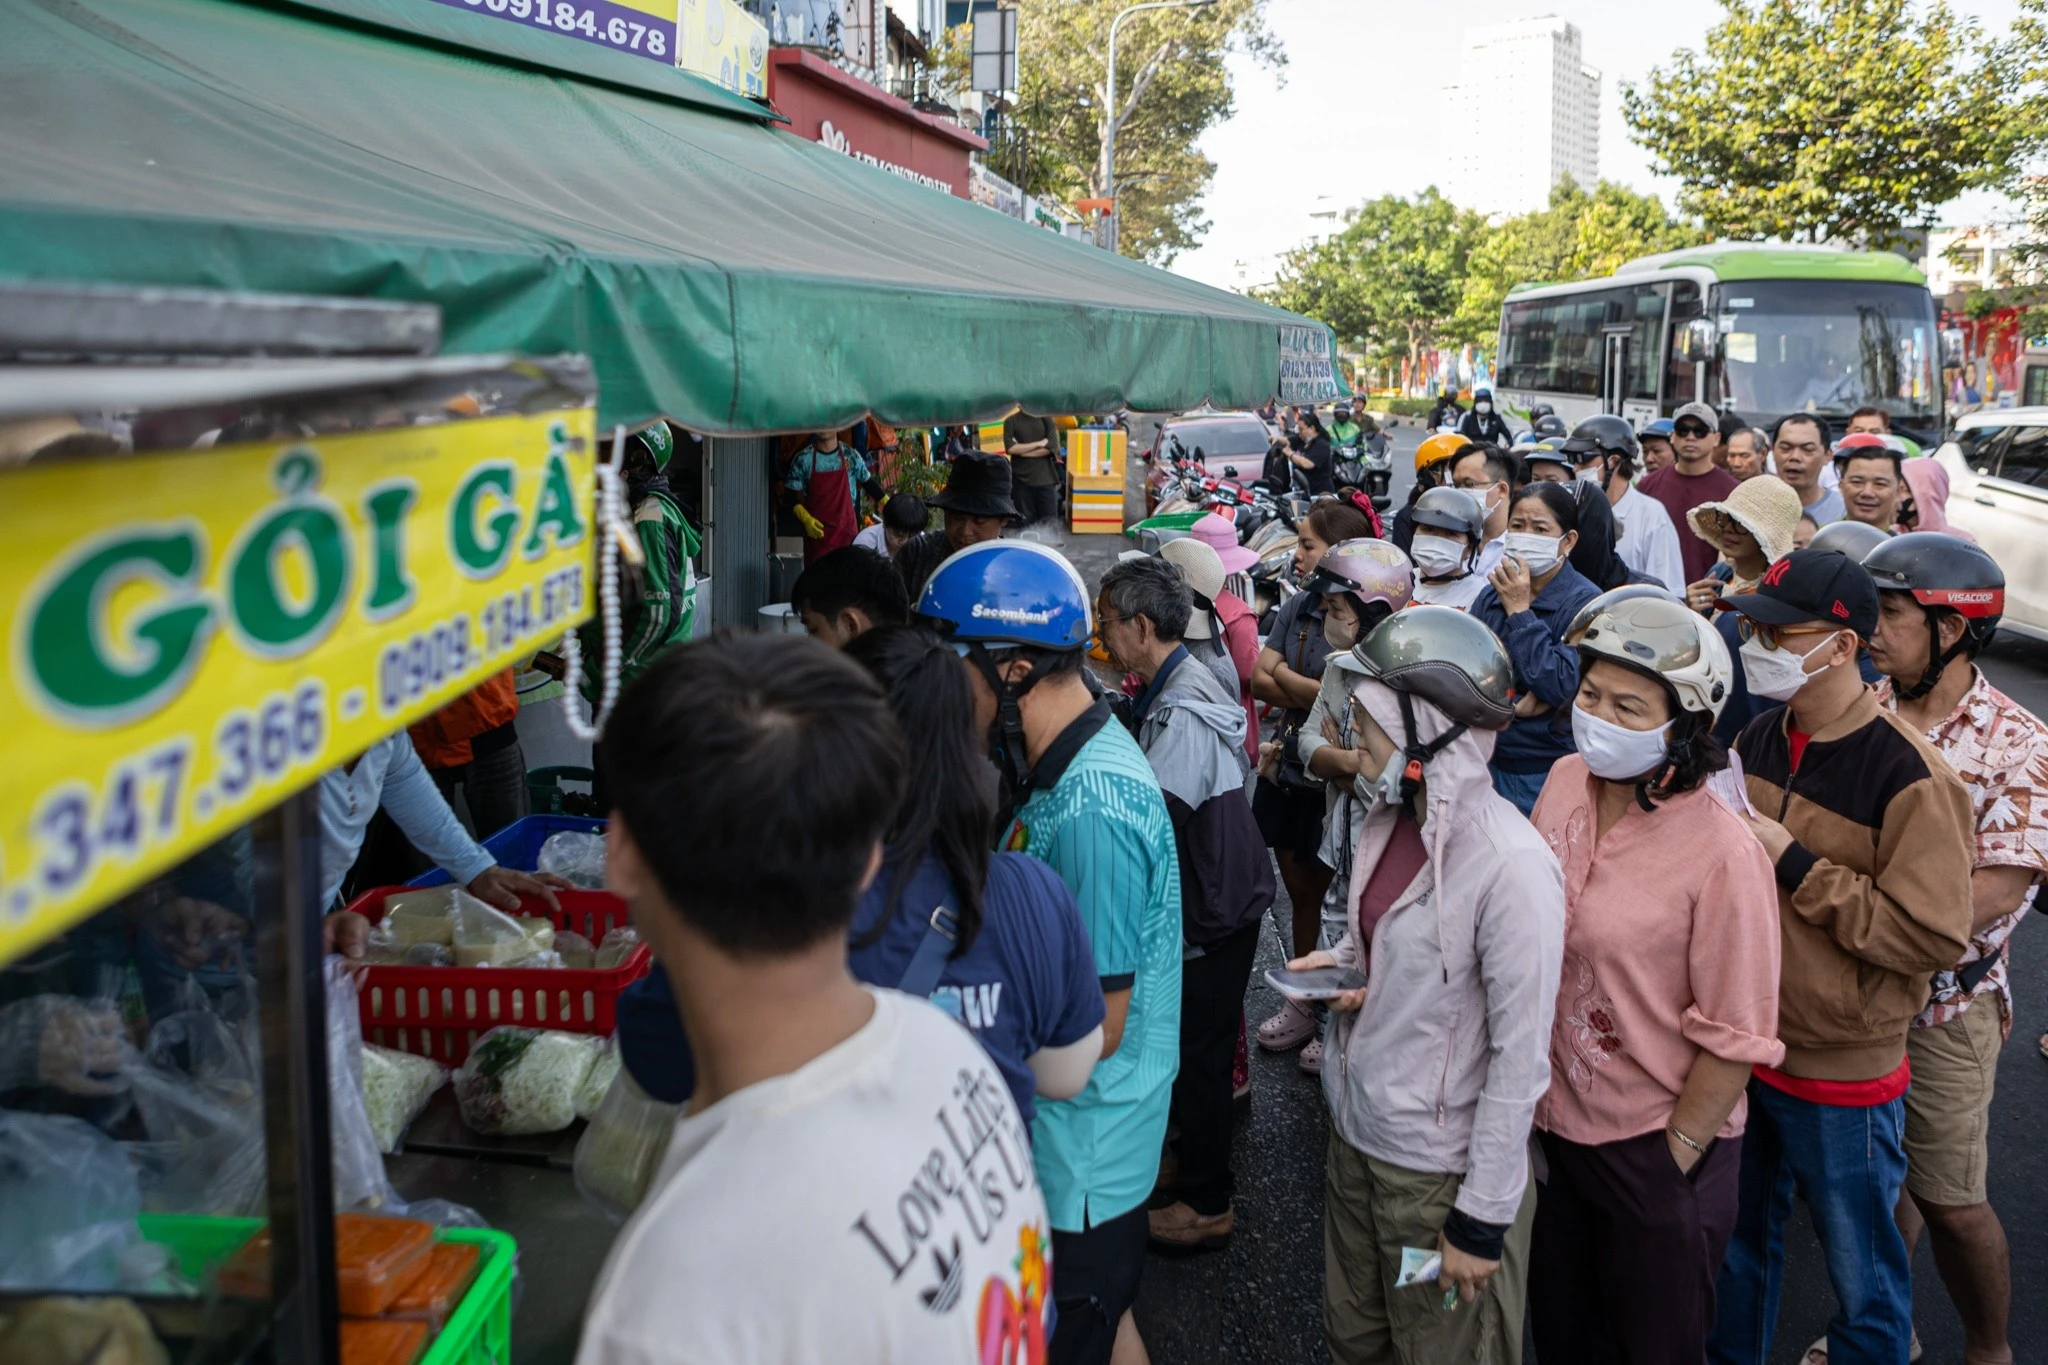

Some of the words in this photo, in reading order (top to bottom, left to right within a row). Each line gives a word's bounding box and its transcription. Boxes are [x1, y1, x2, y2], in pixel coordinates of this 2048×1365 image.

[463, 0, 667, 56] 9184.678
[20, 447, 418, 722] GỎI
[971, 603, 1049, 624] Sacombank
[849, 1147, 955, 1285] Love
